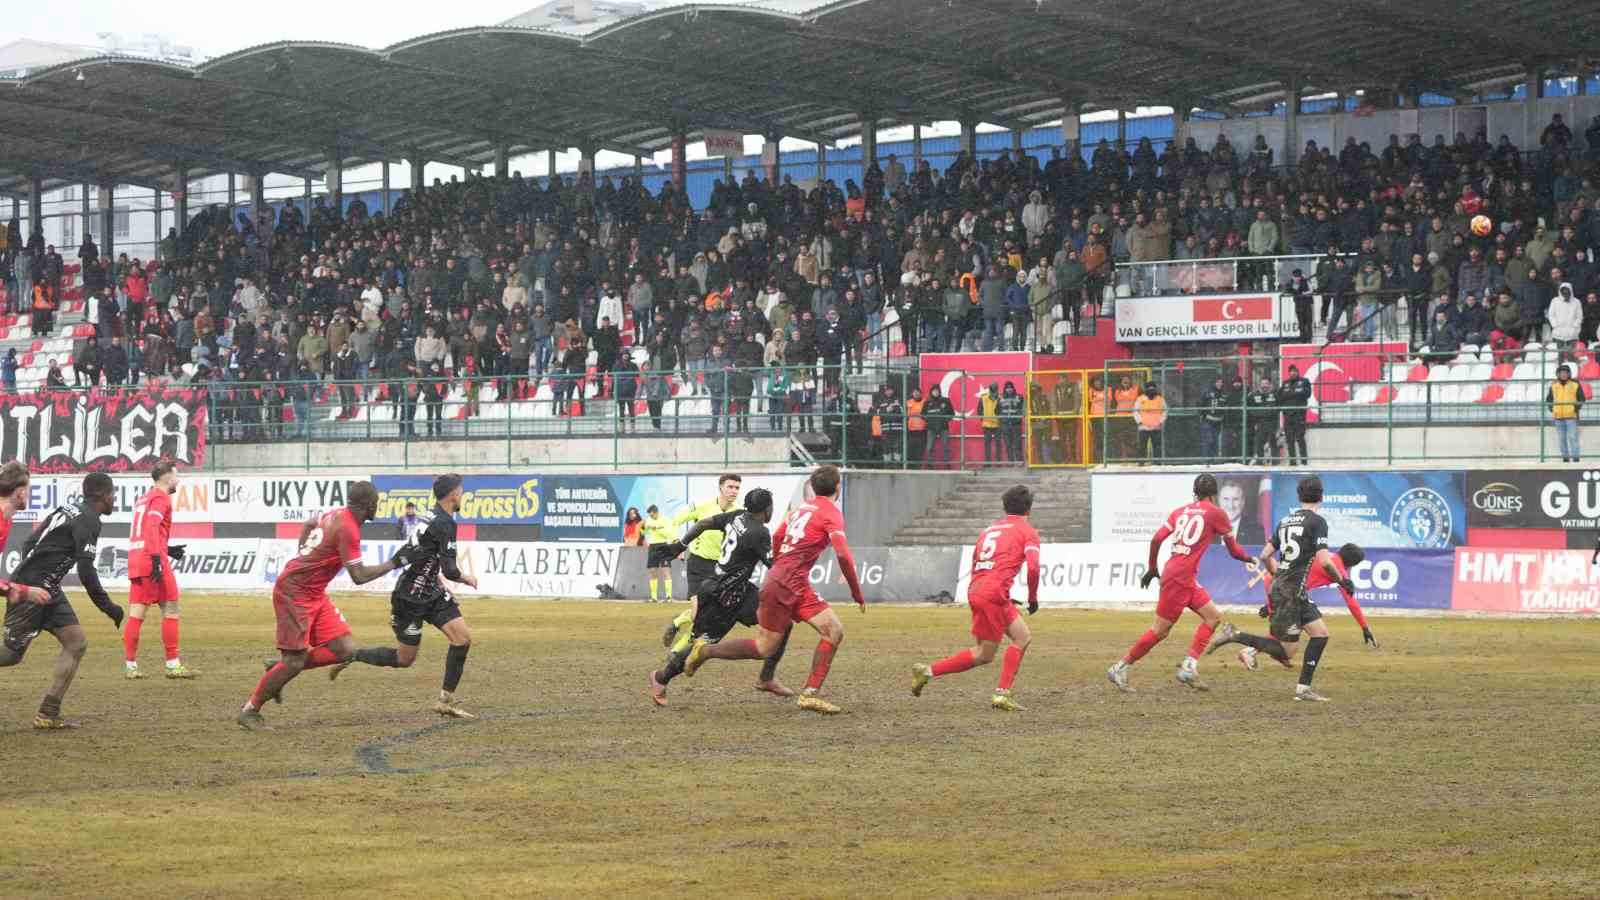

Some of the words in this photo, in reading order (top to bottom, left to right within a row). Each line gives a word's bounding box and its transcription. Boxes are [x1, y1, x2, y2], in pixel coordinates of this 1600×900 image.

[1119, 327, 1142, 337] VAN
[1146, 324, 1198, 338] GENÇLİK
[1203, 325, 1221, 336] VE
[1223, 323, 1254, 335] SPOR
[1257, 320, 1268, 333] İL
[0, 396, 191, 464] TLİLER
[263, 481, 307, 506] UKY
[1473, 489, 1522, 512] GÜNEŞ
[1173, 514, 1205, 548] 80
[1279, 526, 1304, 561] 15
[980, 531, 1003, 562] 5
[171, 551, 256, 574] ANGÖLÜ
[484, 547, 616, 577] MABEYN
[1350, 560, 1399, 590] CO
[1458, 552, 1537, 584] HMT
[1520, 586, 1600, 609] TAAHHÜ
